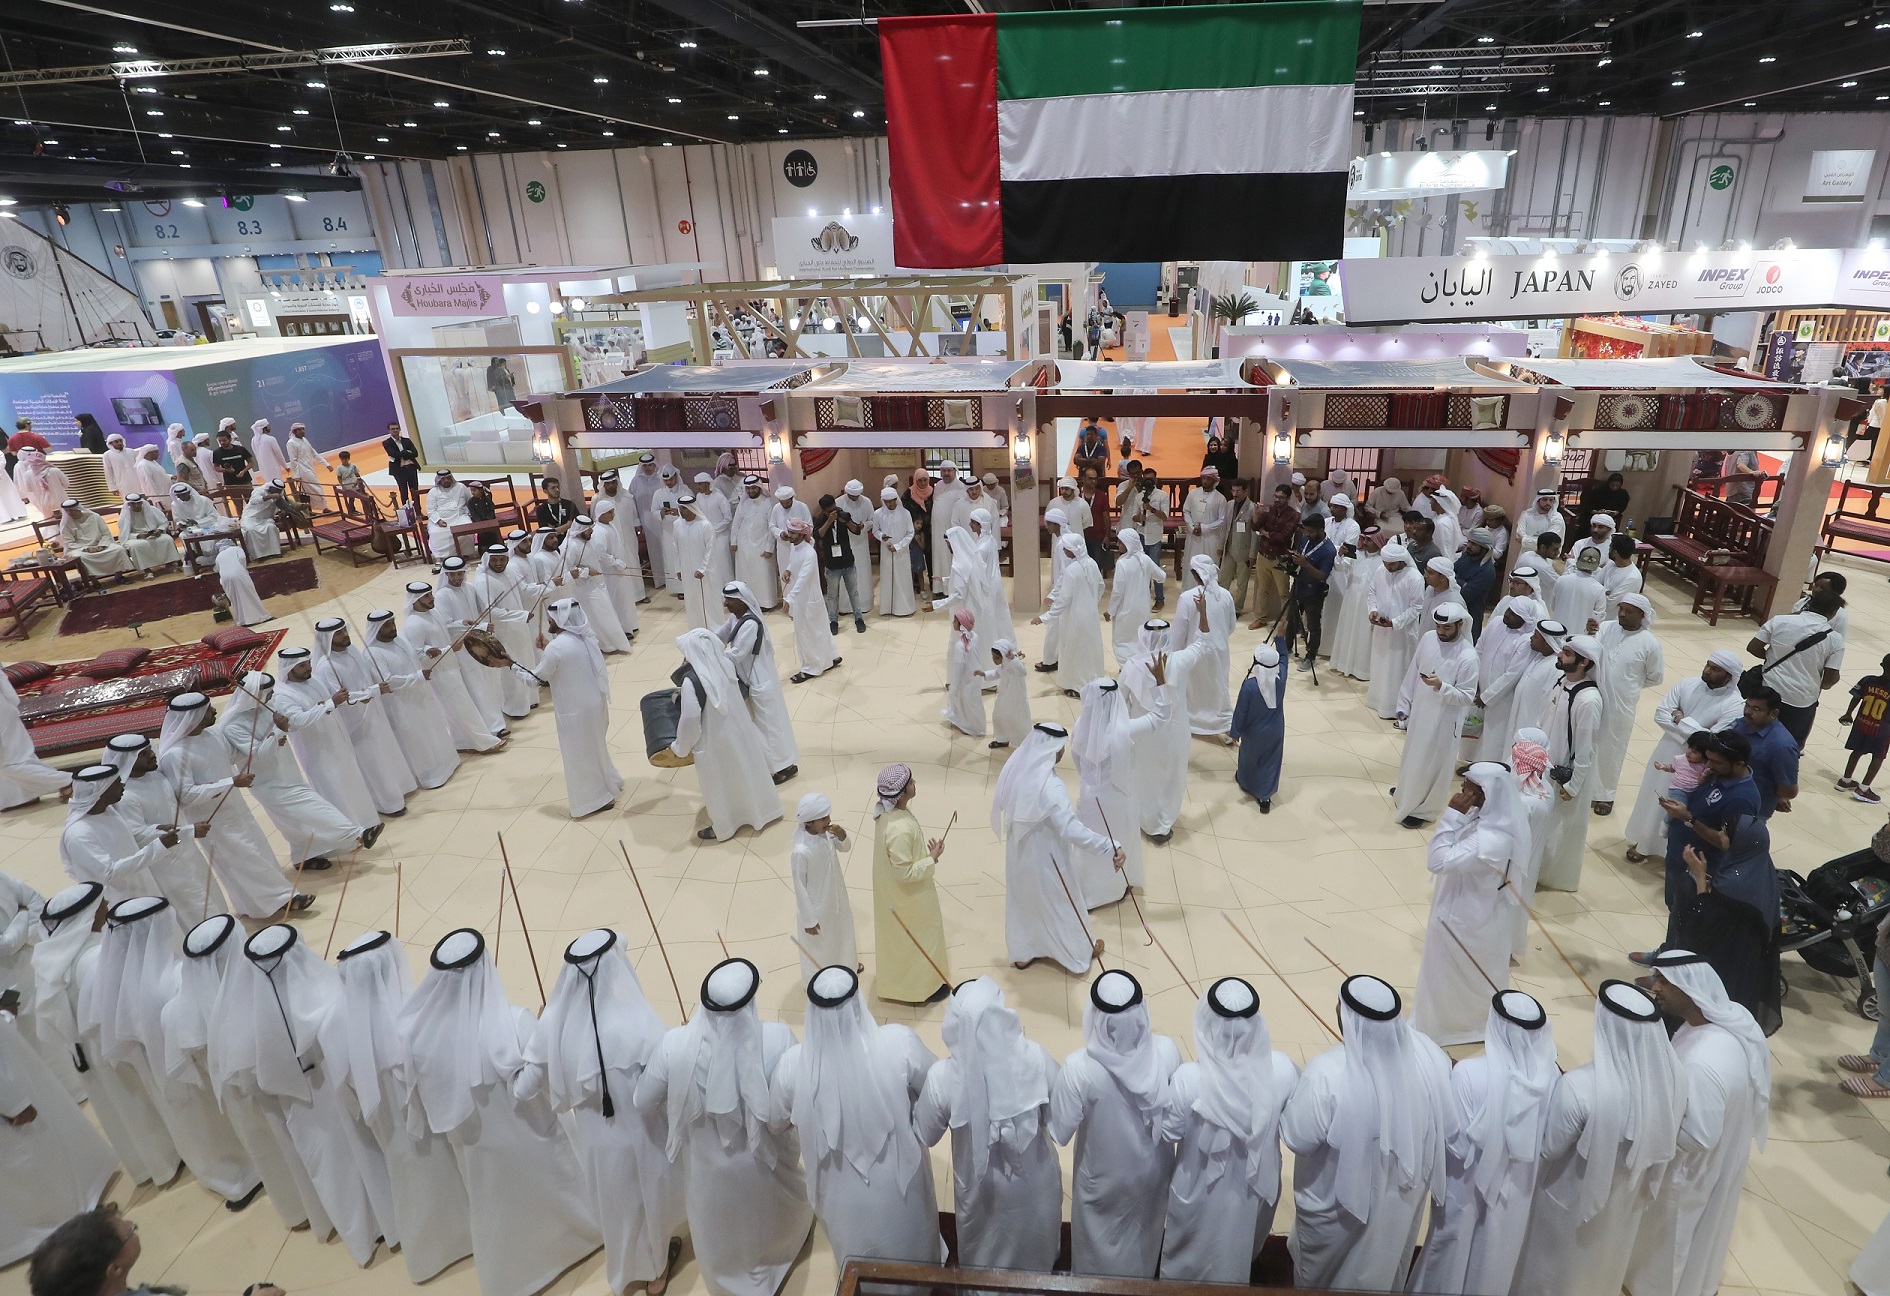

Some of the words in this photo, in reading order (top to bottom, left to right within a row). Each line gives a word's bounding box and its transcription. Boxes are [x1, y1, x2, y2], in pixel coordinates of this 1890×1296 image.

[237, 220, 263, 236] 8.3
[322, 216, 348, 232] 8.4
[154, 224, 180, 240] 8.2
[1697, 268, 1750, 282] INPEX
[1852, 269, 1890, 281] INPE
[1420, 267, 1493, 307] اليابان
[1510, 269, 1597, 299] JAPAN
[1647, 280, 1678, 290] ZAYED
[1719, 281, 1744, 291] Group
[1756, 285, 1784, 294] JODCO
[416, 298, 453, 308] Houbara
[453, 298, 478, 310] Majlis
[256, 379, 265, 388] 21
[1862, 694, 1888, 721] 10
